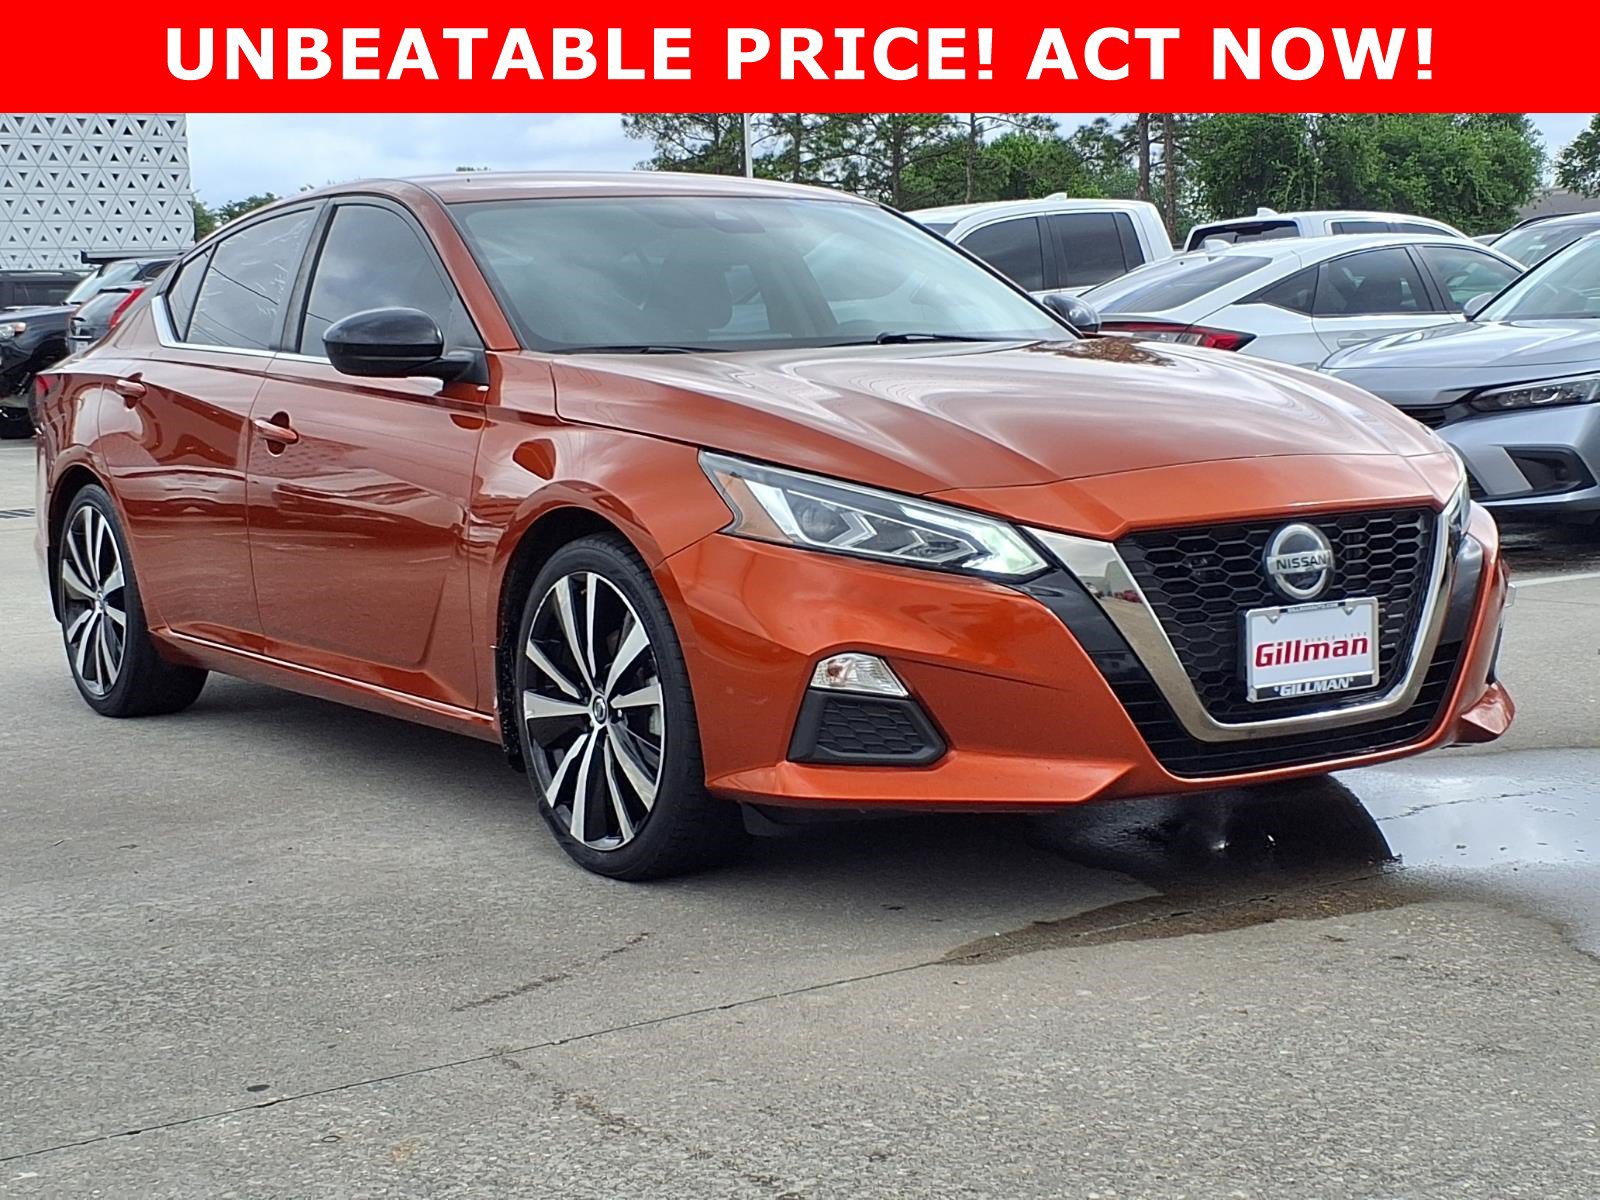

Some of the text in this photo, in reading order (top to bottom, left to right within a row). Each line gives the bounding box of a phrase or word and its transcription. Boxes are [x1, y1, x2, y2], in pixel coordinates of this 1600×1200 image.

[1276, 554, 1328, 570] NISSAN
[1255, 636, 1368, 667] Gillman
[1279, 678, 1350, 697] GILLMAN
